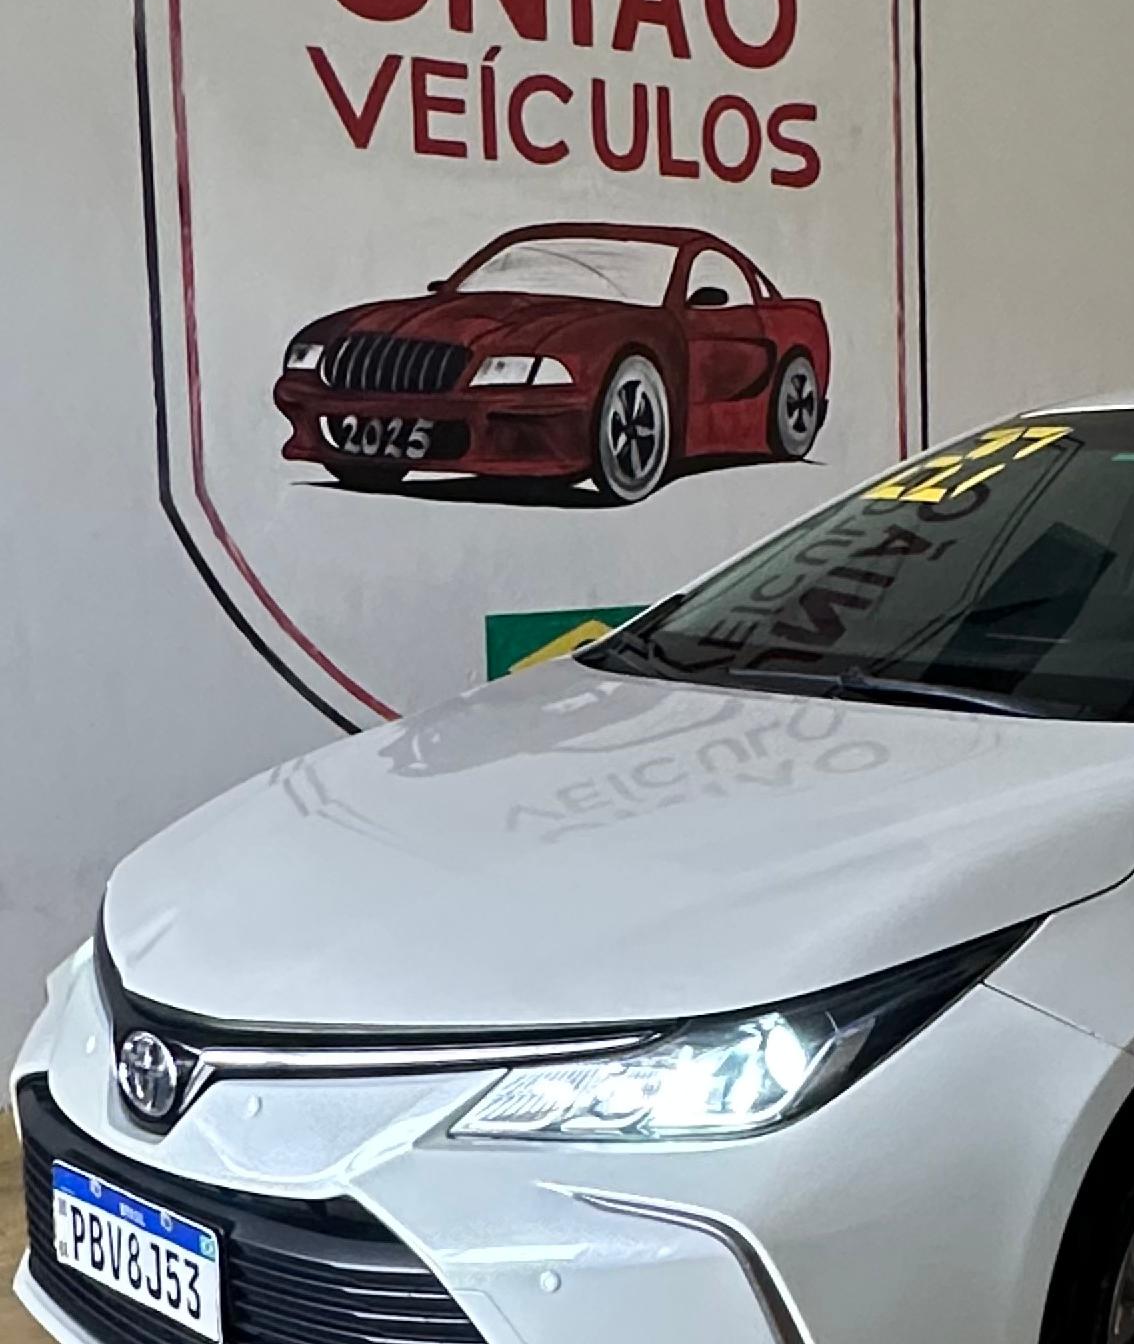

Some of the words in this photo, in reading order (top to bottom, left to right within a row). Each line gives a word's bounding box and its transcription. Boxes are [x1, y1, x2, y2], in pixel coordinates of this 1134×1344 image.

[305, 45, 821, 188] VEÍCULOS
[342, 414, 435, 459] 2025
[70, 1204, 201, 1320] PBV8J53
